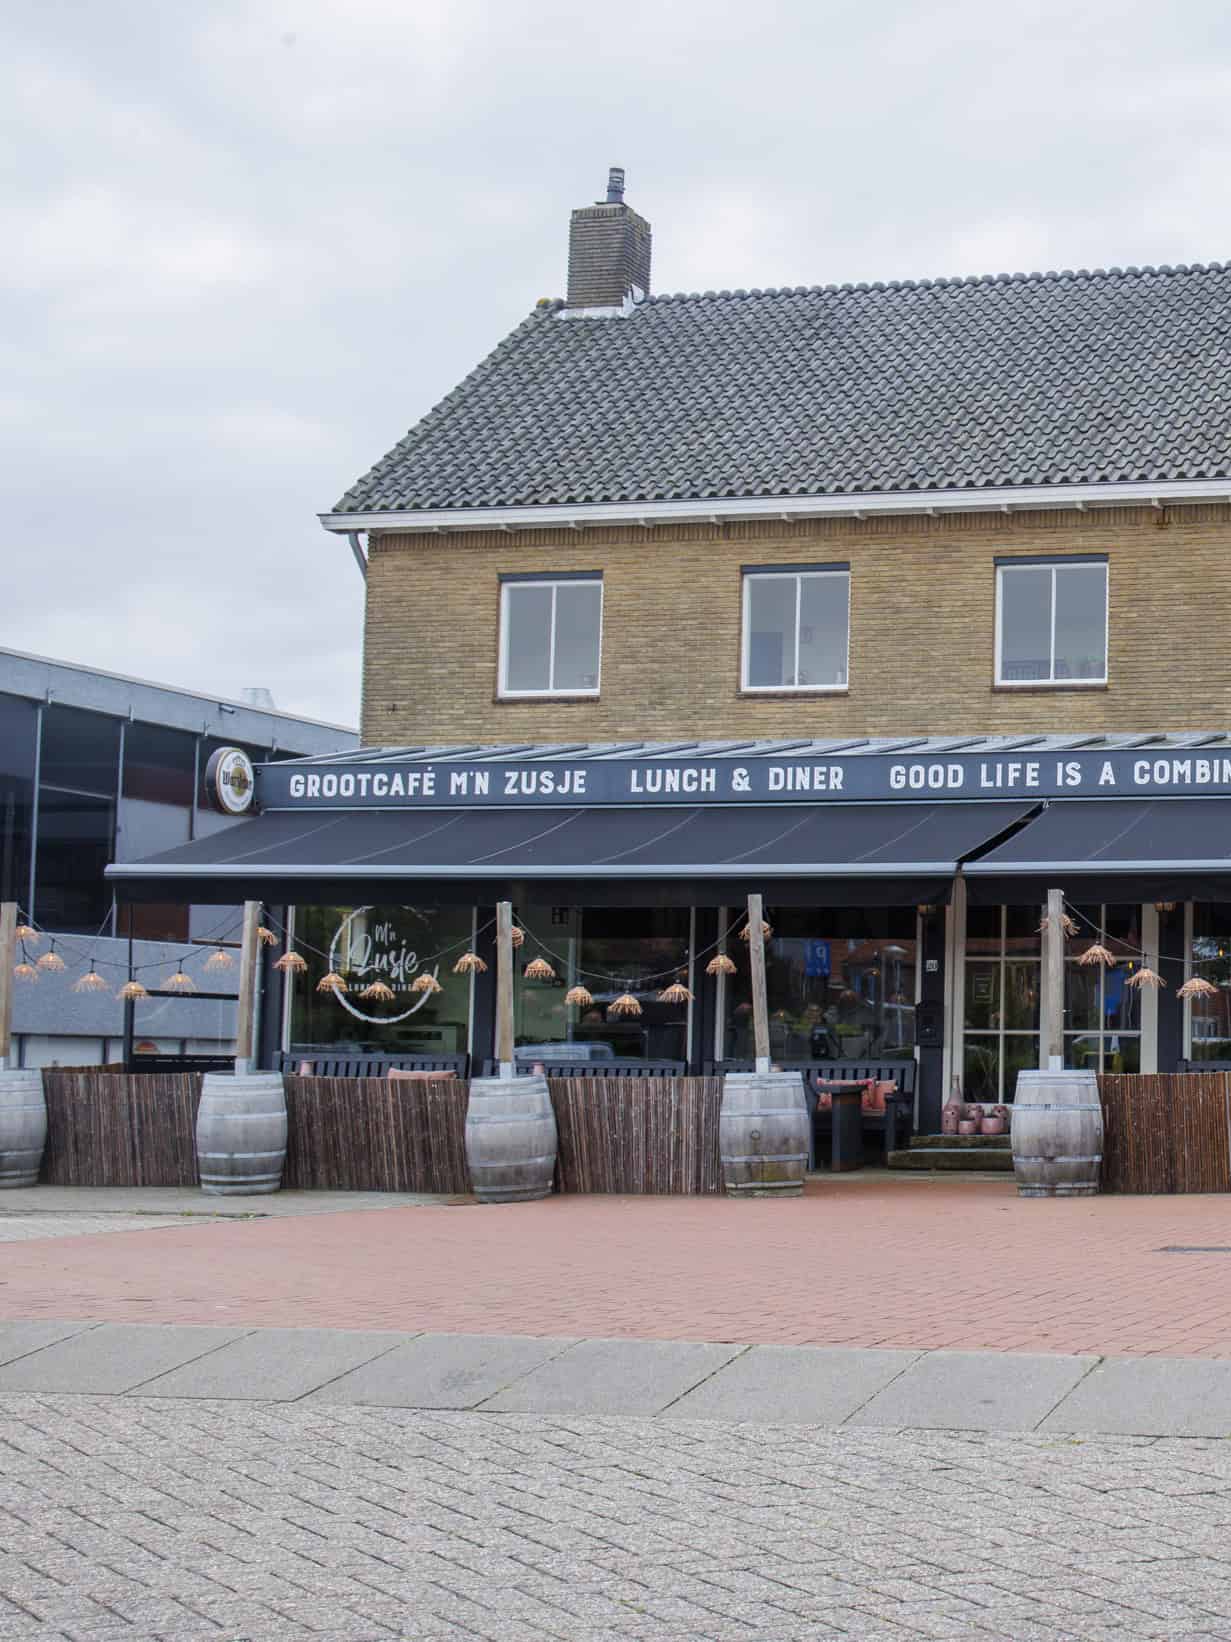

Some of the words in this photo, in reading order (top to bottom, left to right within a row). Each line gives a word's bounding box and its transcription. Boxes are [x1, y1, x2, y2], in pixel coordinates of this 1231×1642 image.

[288, 766, 437, 798] GROOTCAFÉ
[449, 770, 491, 796] M'N
[503, 769, 588, 795] ZUSJE
[629, 767, 716, 793] LUNCH
[731, 767, 753, 792] &
[768, 766, 844, 791] DINER
[889, 764, 964, 790] GOOD
[980, 762, 1040, 788] LIFE
[1056, 761, 1082, 787] IS
[1098, 761, 1116, 786] A
